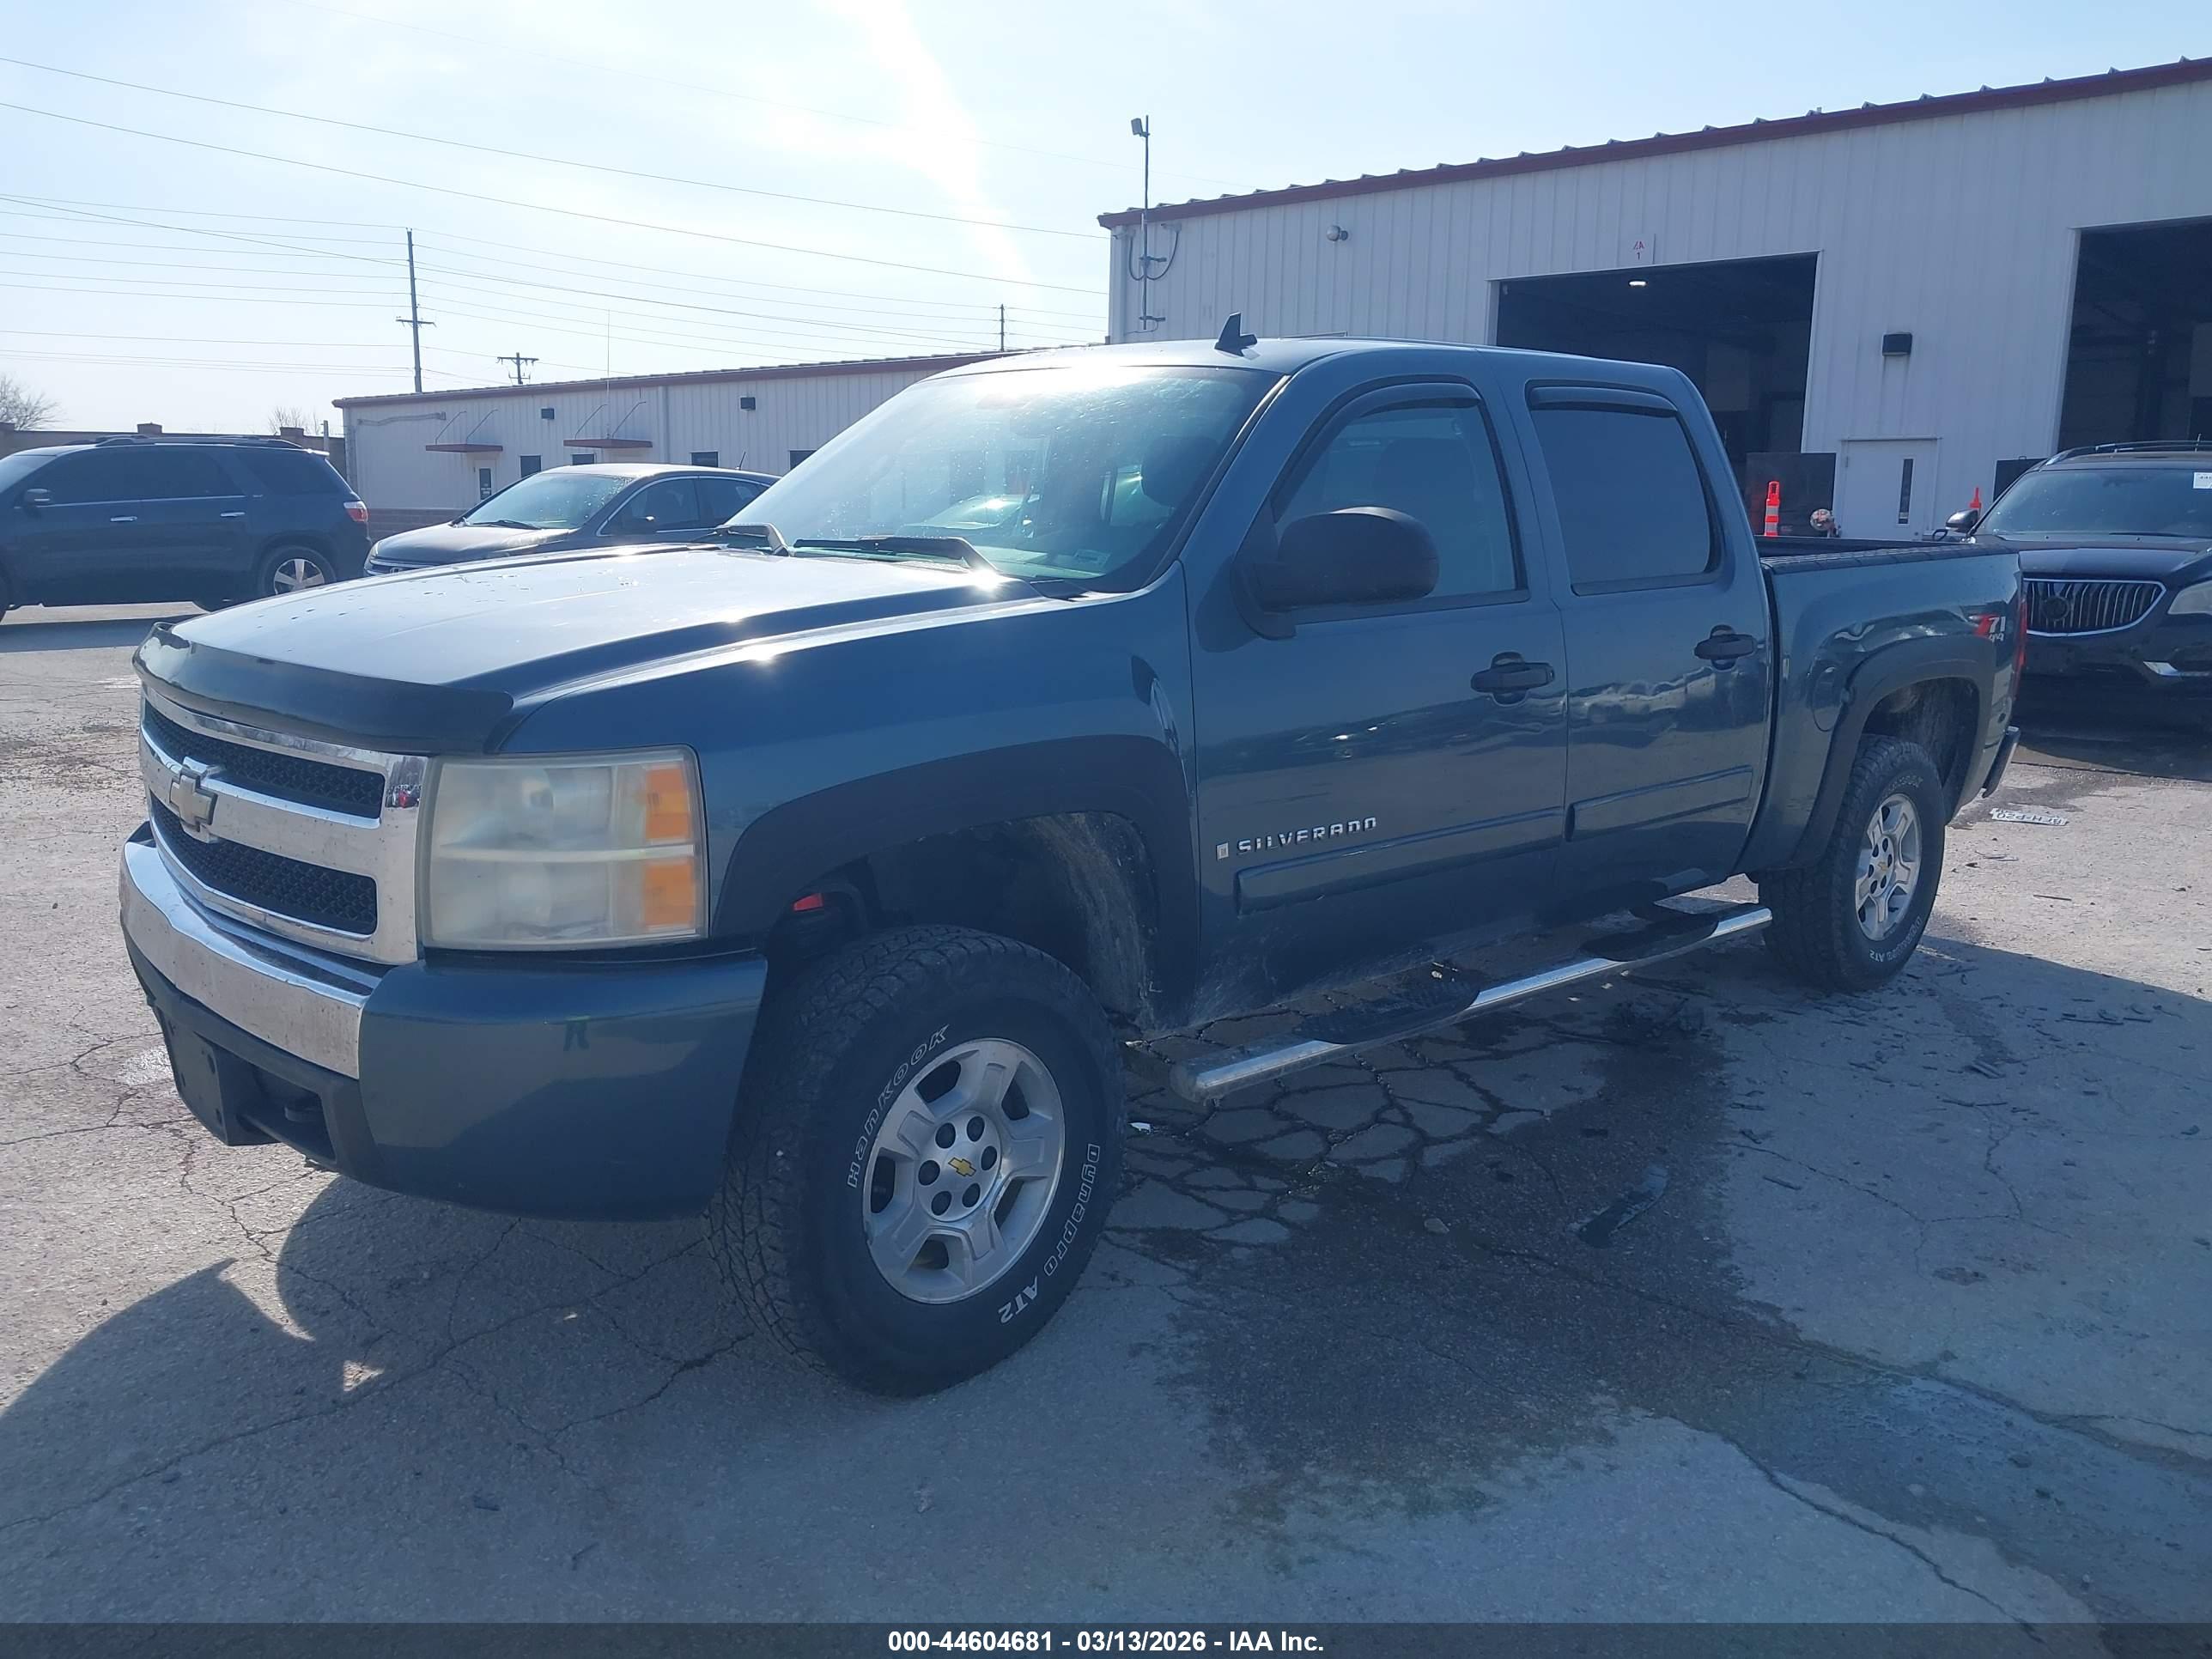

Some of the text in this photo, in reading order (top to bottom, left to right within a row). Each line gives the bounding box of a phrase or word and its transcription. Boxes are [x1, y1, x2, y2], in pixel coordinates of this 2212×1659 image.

[1636, 252, 1641, 261] 1
[1237, 817, 1377, 853] SILVERADO
[998, 1143, 1101, 1324] Dynapro AT2
